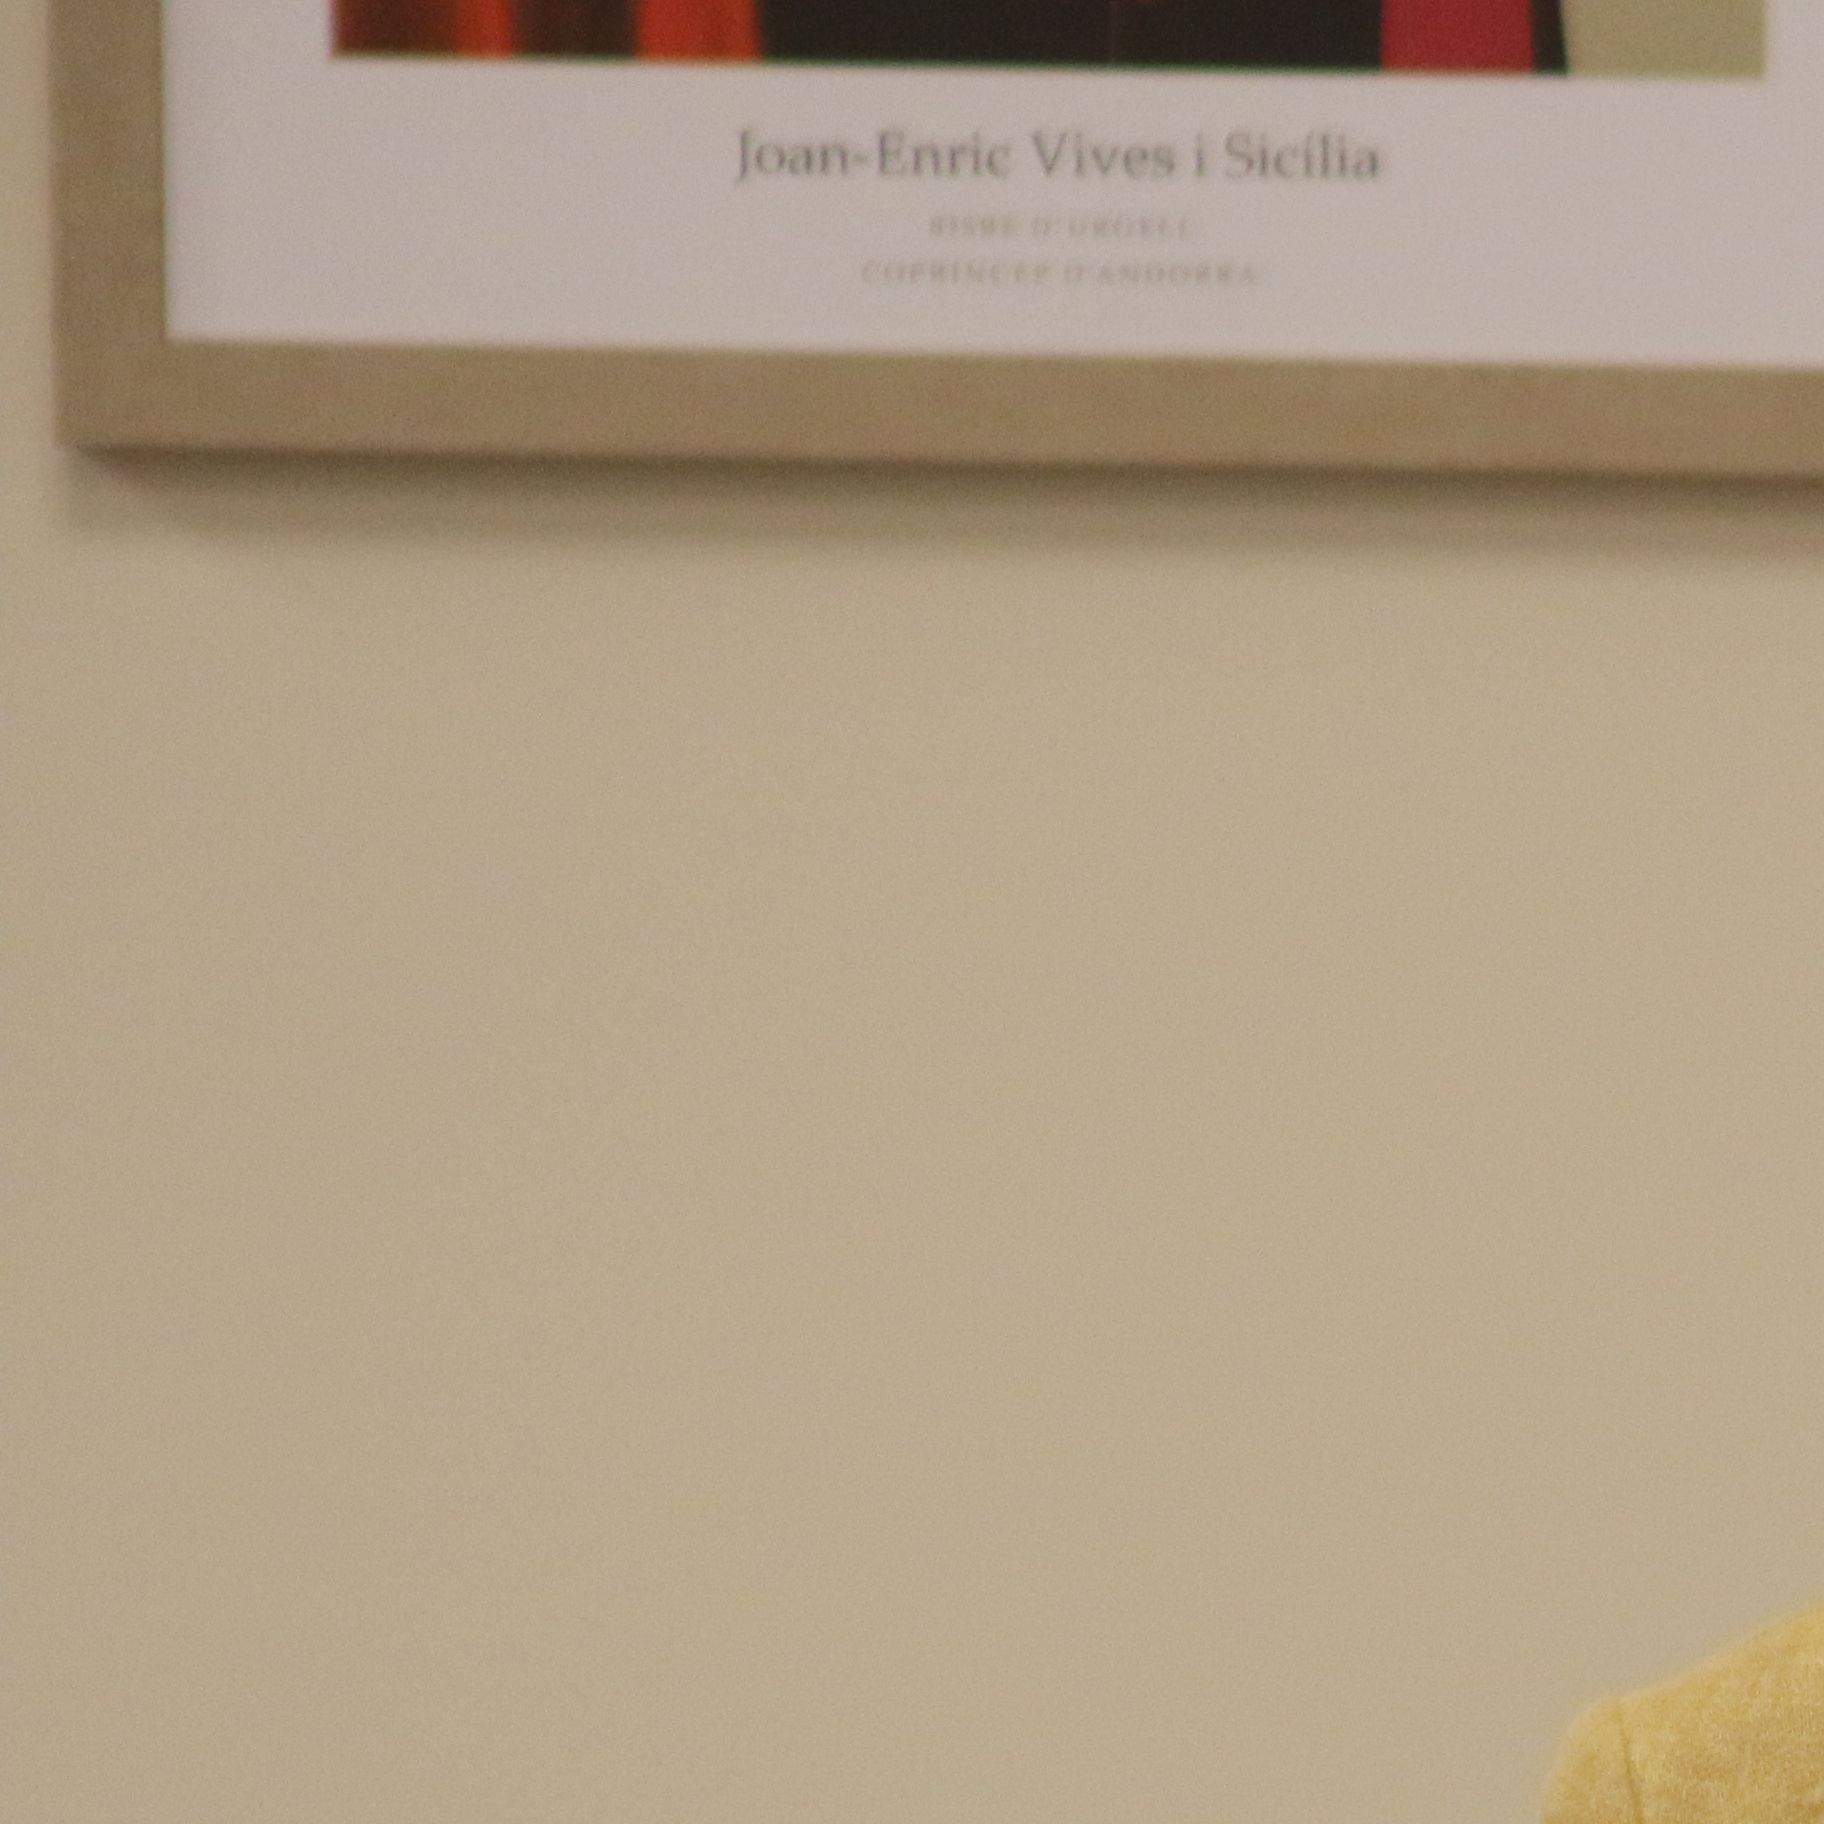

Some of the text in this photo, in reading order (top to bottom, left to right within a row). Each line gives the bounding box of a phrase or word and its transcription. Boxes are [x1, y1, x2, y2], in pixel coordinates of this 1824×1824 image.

[736, 127, 1384, 182] Joan-Enric Vives i Sicília
